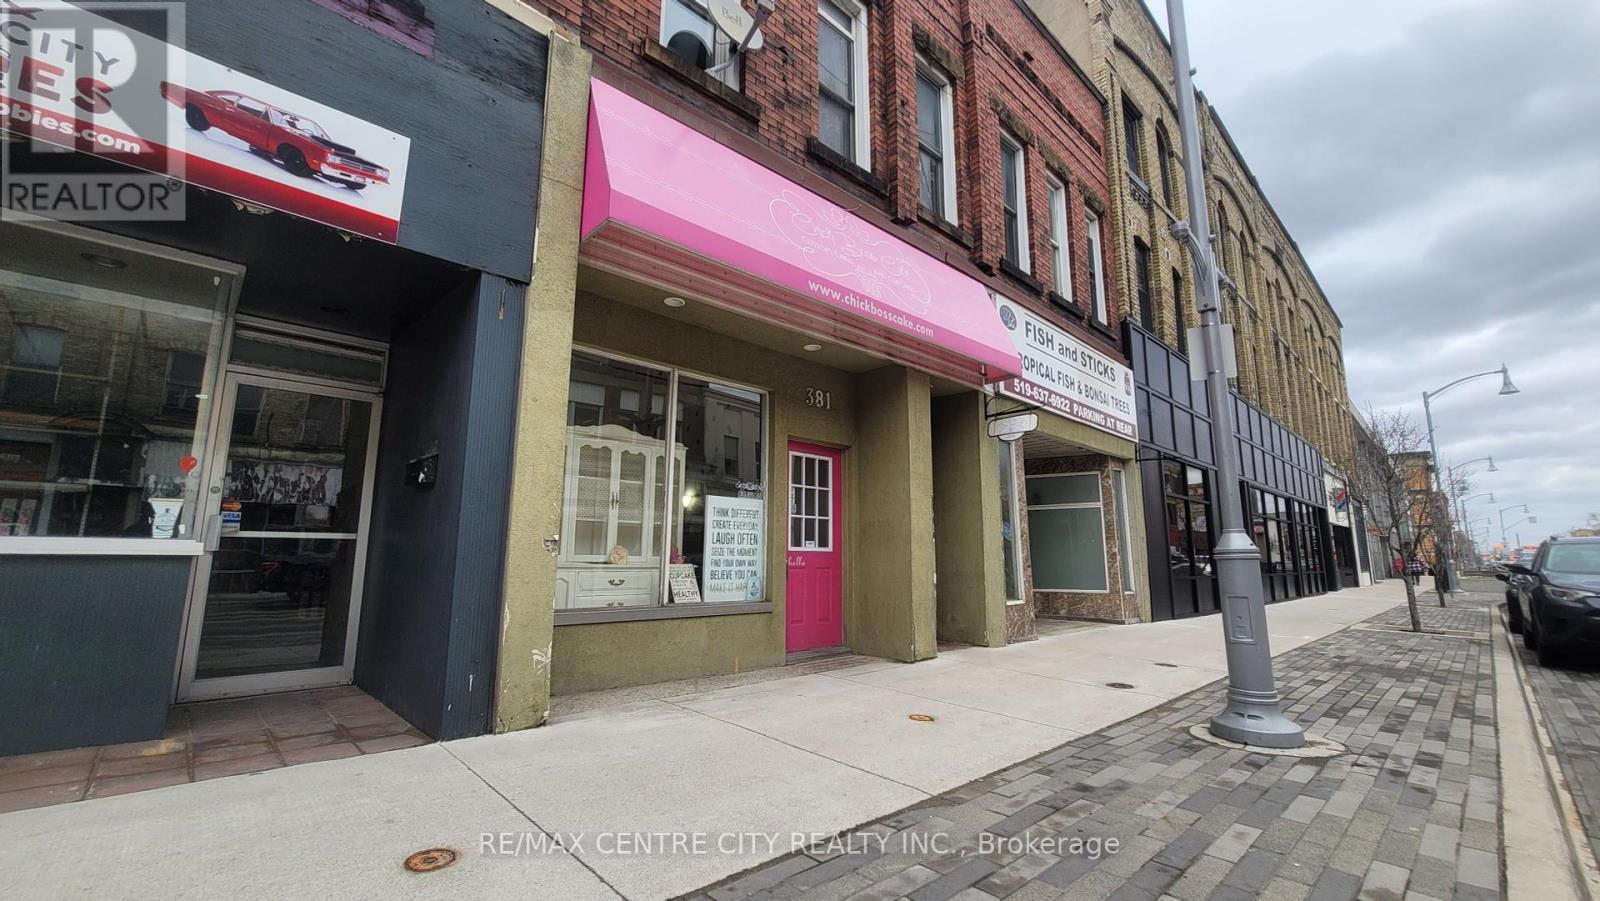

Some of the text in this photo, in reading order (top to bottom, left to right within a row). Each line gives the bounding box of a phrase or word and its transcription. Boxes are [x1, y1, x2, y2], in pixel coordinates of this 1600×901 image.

[0, 21, 120, 75] CITY
[0, 50, 113, 113] ES
[808, 279, 934, 338] www.chickbosscake.com
[1025, 320, 1116, 382] FISH and STICKS
[806, 387, 831, 409] 381
[1057, 370, 1075, 391] FISH
[1077, 380, 1083, 395] &
[1084, 384, 1109, 407] BONSAI
[1110, 395, 1131, 415] TREES
[1014, 378, 1133, 436] 519-637-6922 PARKING AT REAR
[713, 507, 729, 518] THINK
[712, 520, 732, 530] CREATE
[712, 532, 758, 546] LAUGH OFTEN
[711, 546, 758, 557] SEIZE THE MOMENT
[710, 559, 757, 568] FIND YOUR OWN WAY
[710, 570, 757, 580] BELIEVE YOU CAN
